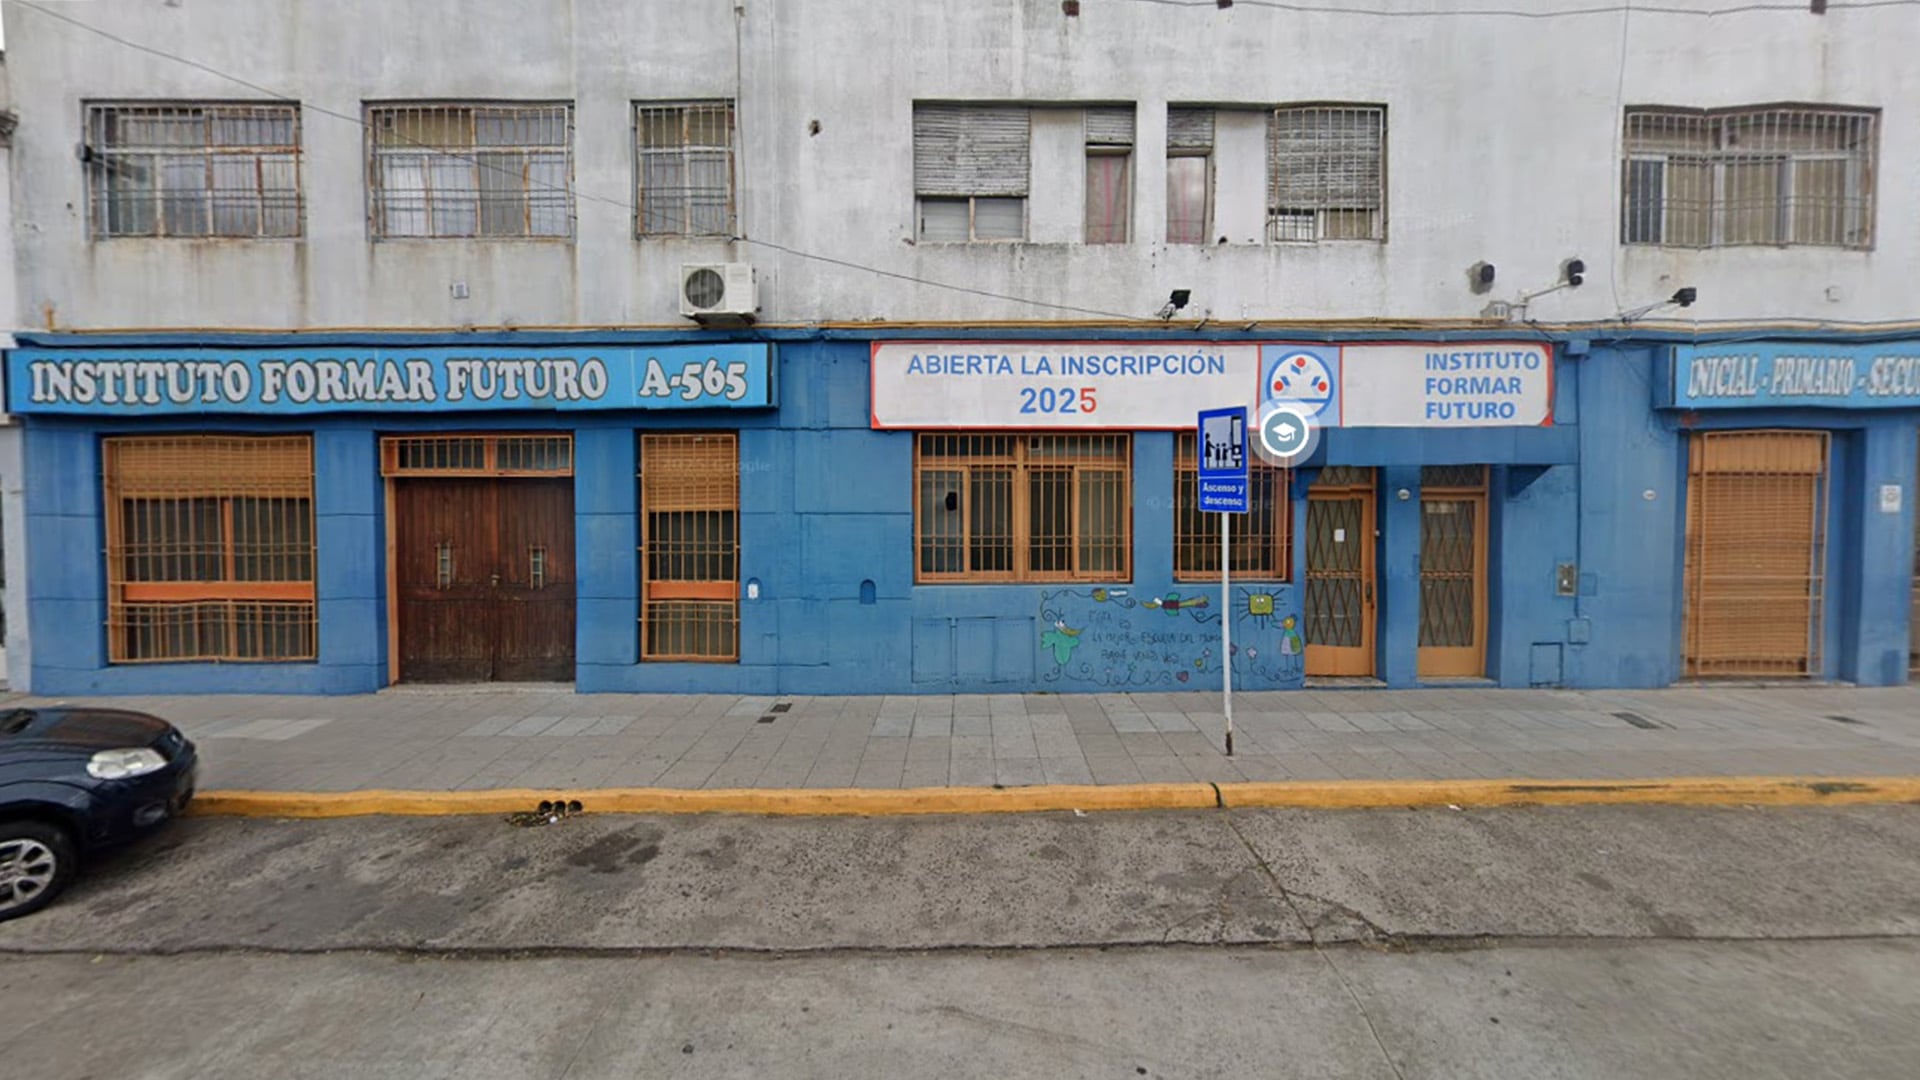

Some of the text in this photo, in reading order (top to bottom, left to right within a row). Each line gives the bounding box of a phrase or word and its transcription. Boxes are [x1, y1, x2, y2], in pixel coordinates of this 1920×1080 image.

[907, 350, 1226, 375] ABIERTA LA INSCRIPCIÓN
[1425, 352, 1540, 370] INSTITUTO
[29, 358, 748, 404] INSTITUTO FORMAR FUTURO A-565
[1687, 355, 1760, 398] INICIAL
[1769, 356, 1855, 397] PRIMARIO
[1425, 377, 1522, 395] FORMAR
[1019, 387, 1098, 414] 2025
[1425, 402, 1516, 420] FUTURO
[1203, 482, 1244, 495] Ascenso y
[1204, 496, 1242, 506] descenso
